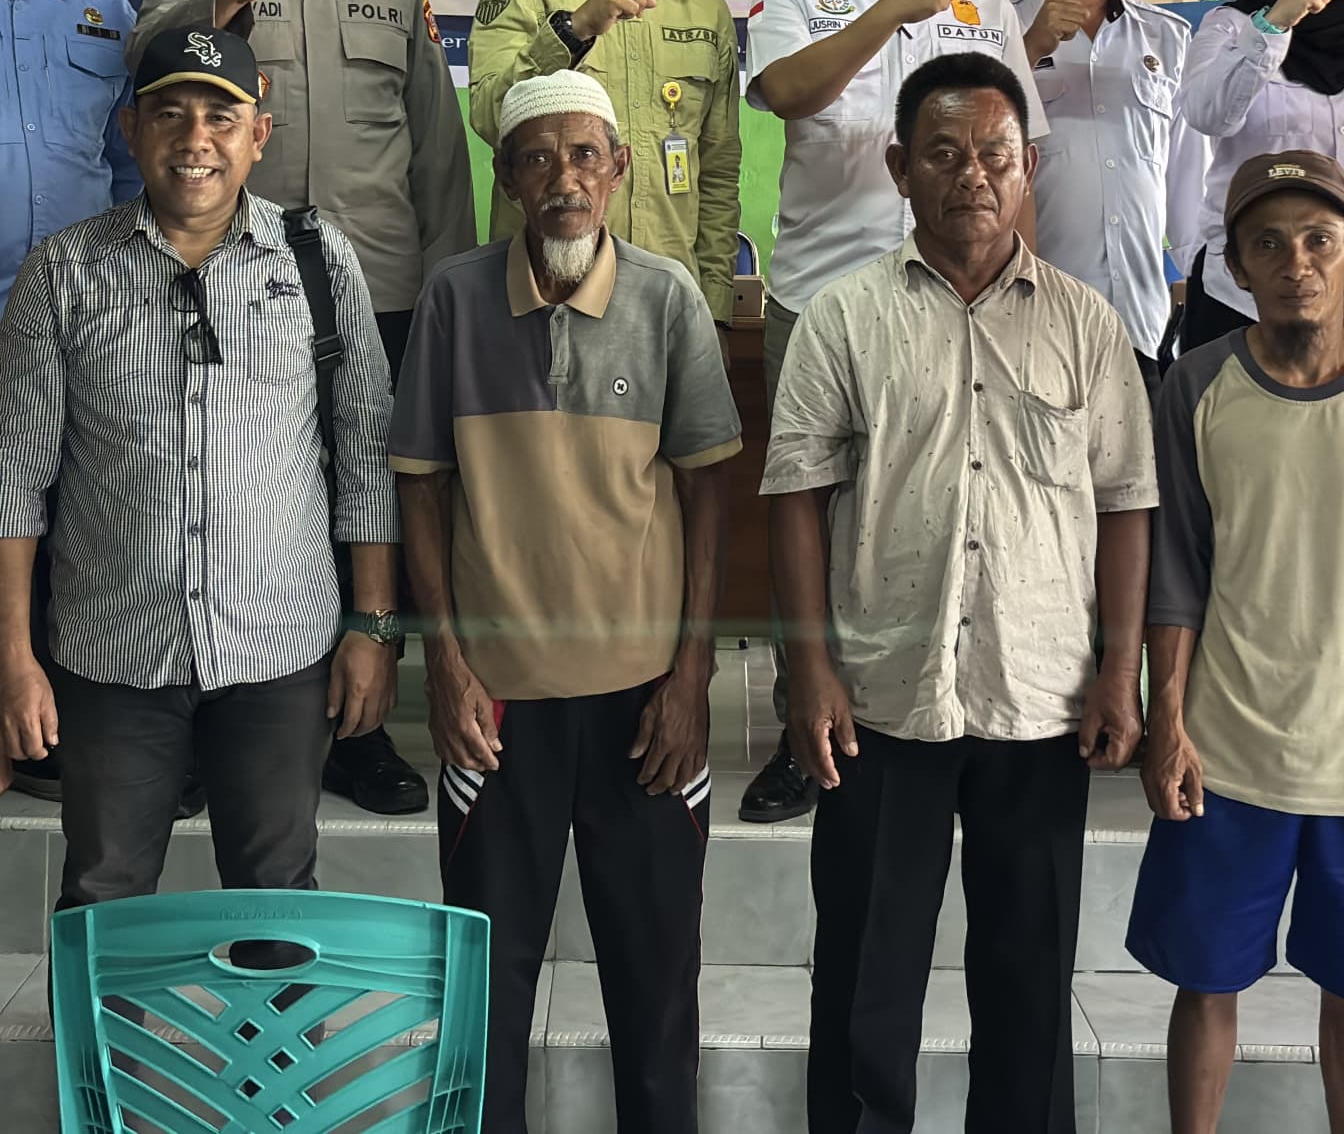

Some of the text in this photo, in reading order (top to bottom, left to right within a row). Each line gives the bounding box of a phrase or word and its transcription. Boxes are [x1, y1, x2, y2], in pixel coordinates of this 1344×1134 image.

[348, 4, 403, 24] POLRI
[811, 20, 842, 31] JUSRIN
[942, 27, 1000, 42] DATUN
